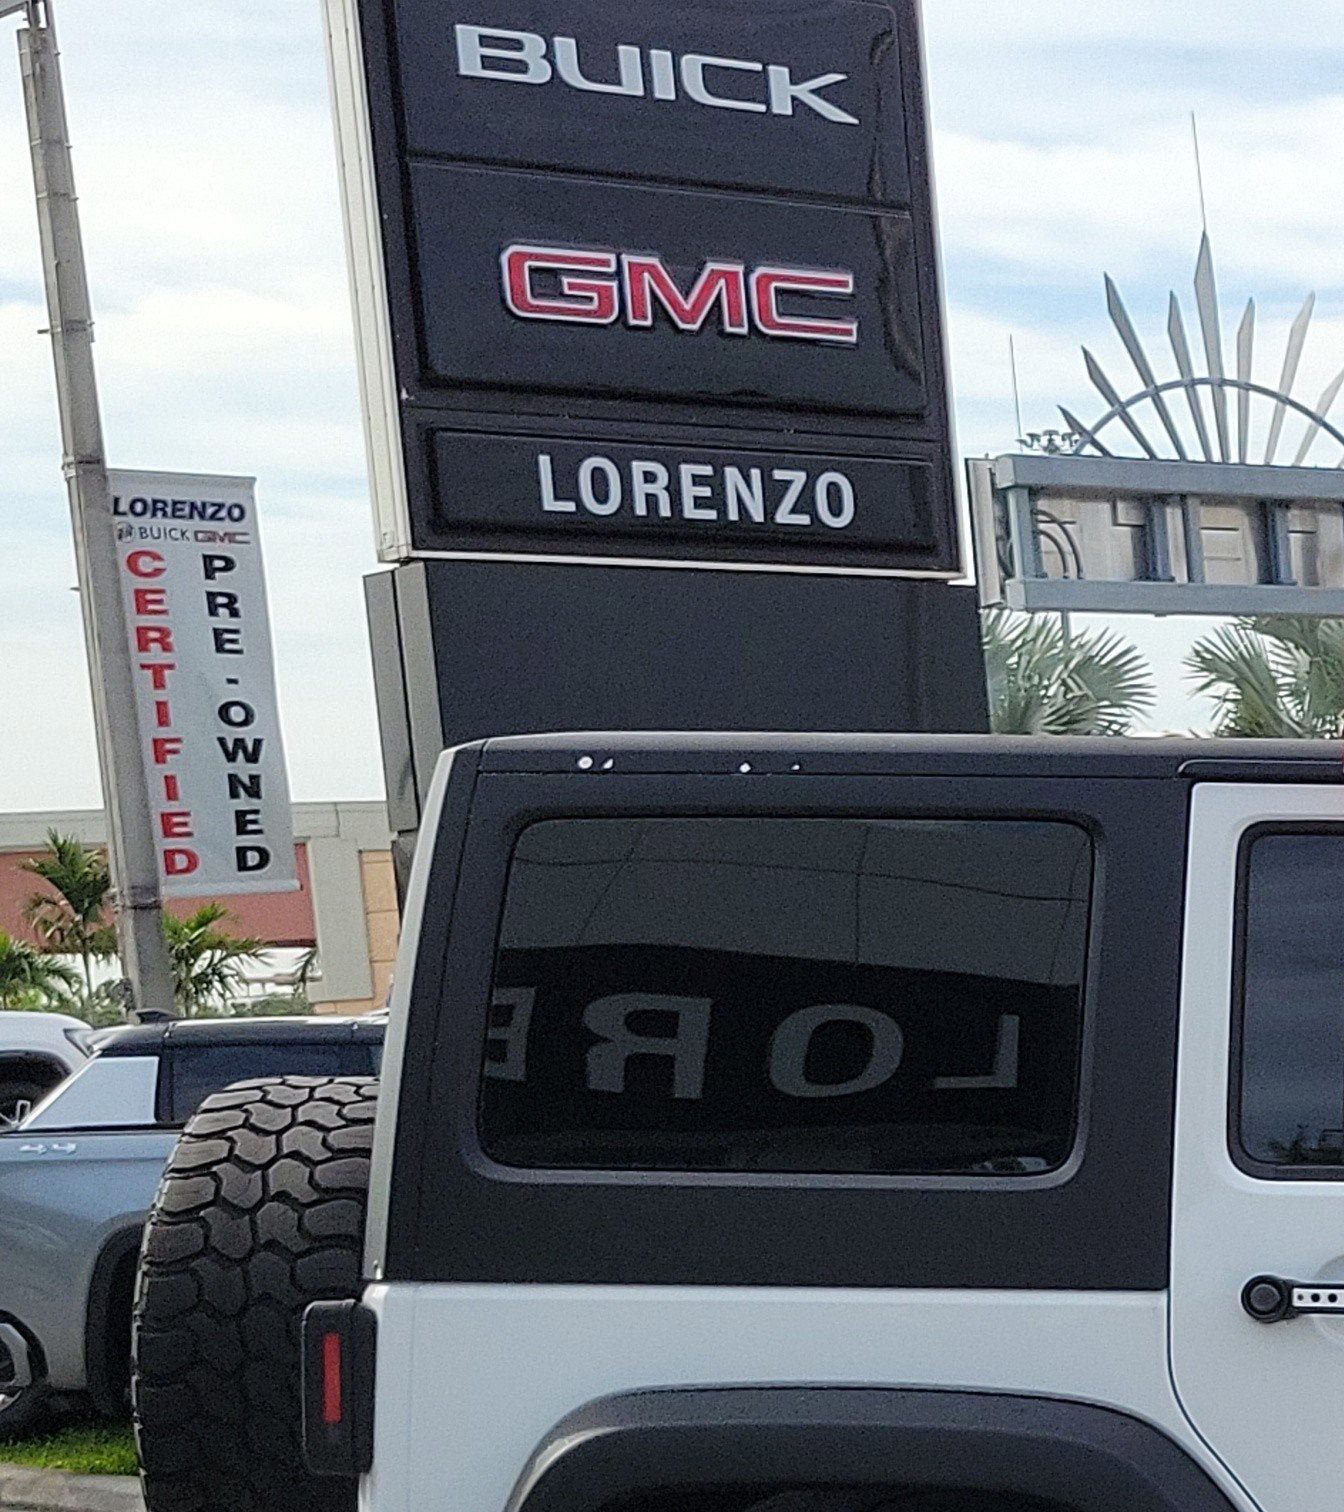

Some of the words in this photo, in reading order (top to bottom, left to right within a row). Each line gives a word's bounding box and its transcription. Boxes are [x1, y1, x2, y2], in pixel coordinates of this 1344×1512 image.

[455, 24, 860, 125] BUICK
[501, 243, 858, 344] GMC
[113, 495, 246, 523] LORENZO
[138, 525, 191, 542] BUICK
[193, 529, 251, 545] GMC
[537, 453, 856, 529] LORENZO
[126, 549, 200, 877] CERTIFIED
